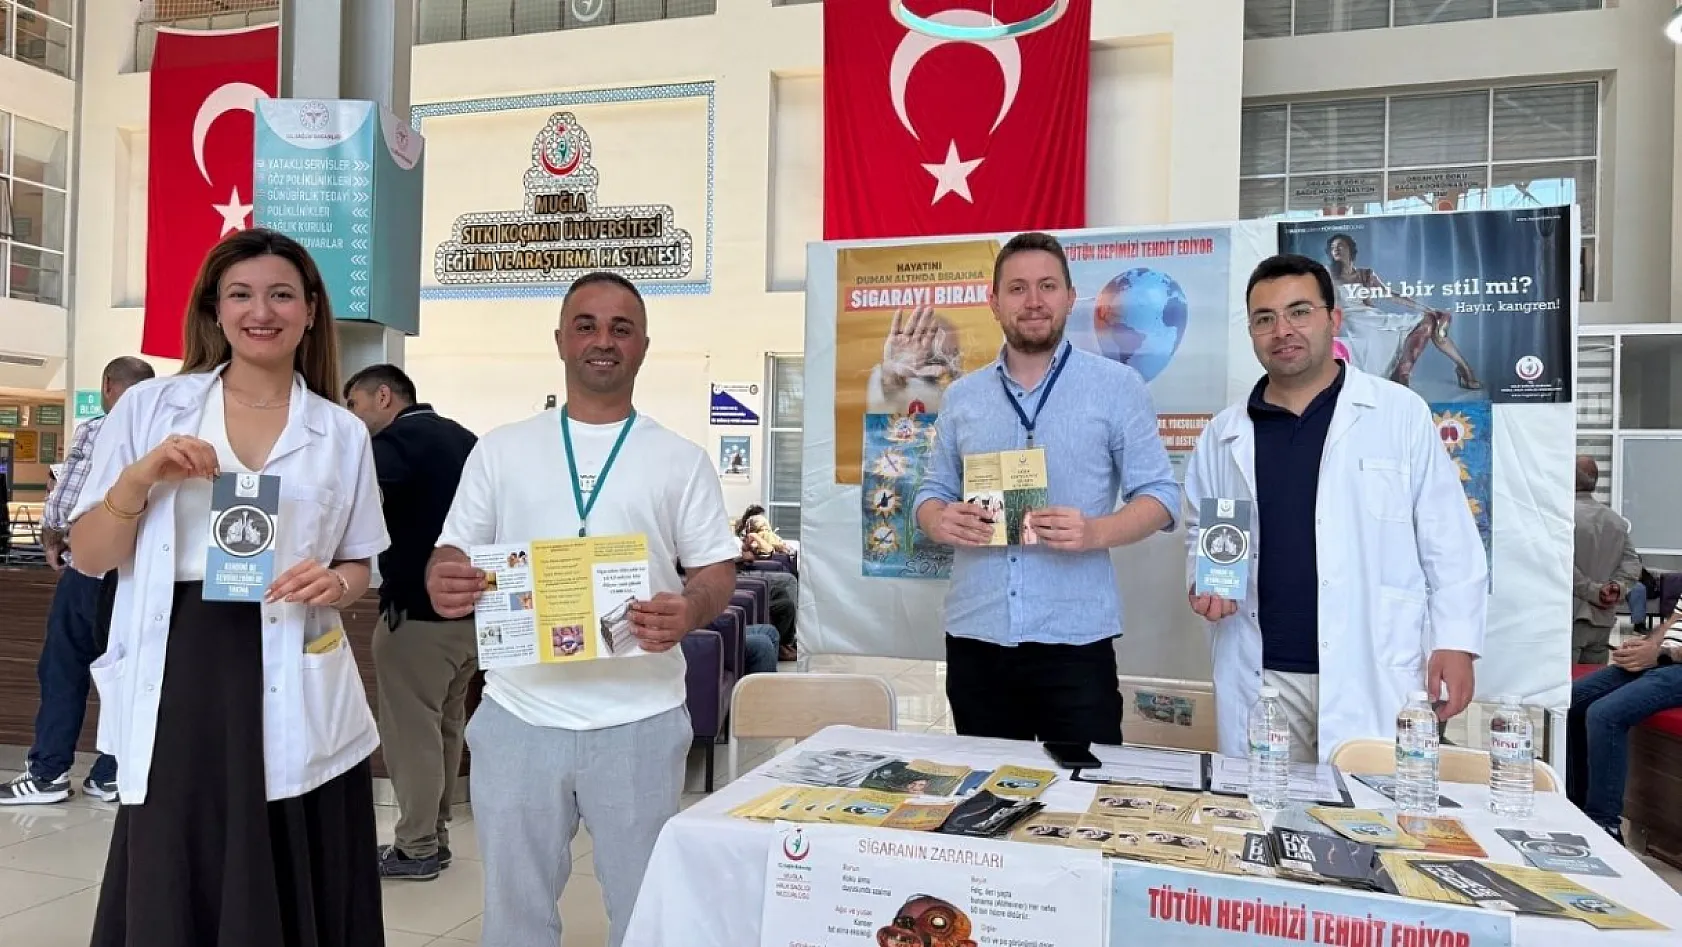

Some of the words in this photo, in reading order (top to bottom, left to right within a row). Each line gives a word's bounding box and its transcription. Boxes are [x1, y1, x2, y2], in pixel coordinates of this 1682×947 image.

[267, 158, 303, 170] YATAKLI
[305, 158, 350, 171] SERVİSLER
[267, 173, 284, 186] GÖZ
[267, 204, 330, 217] POLİKLİNİKLER
[534, 190, 587, 214] MUĞLA
[299, 221, 332, 233] KURULU
[461, 223, 498, 245] SITKI
[499, 219, 561, 248] KOÇMAN
[563, 213, 662, 241] ÜNİVERSİTESİ
[444, 247, 493, 273] EĞİTİM
[494, 249, 513, 270] VE
[513, 246, 597, 275] ARAŞTIRMA
[599, 240, 682, 268] HASTANESİ
[1097, 237, 1140, 260] HEPİMİZİ
[1141, 236, 1176, 258] TEHDİT
[1177, 235, 1214, 256] EDİYOR
[855, 274, 893, 285] DUMAN
[893, 272, 936, 283] ALTINDA
[937, 270, 985, 281] BIRAKMA
[896, 261, 943, 273] HAYATINI
[850, 286, 931, 309] SİGARAYI
[934, 284, 990, 305] BIRAK
[1342, 283, 1392, 300] Yeni
[1400, 280, 1434, 298] bir
[1442, 278, 1480, 296] stil
[1485, 275, 1533, 295] mi?
[1455, 300, 1496, 315] Hayır,
[1497, 298, 1561, 314] kangren!
[858, 837, 928, 860] SİGARANIN
[930, 847, 1005, 869] ZARARLARI
[1148, 884, 1212, 927] TÜTÜN
[1217, 897, 1306, 941] HEPİMİZİ
[1311, 910, 1387, 947] TEHDİT
